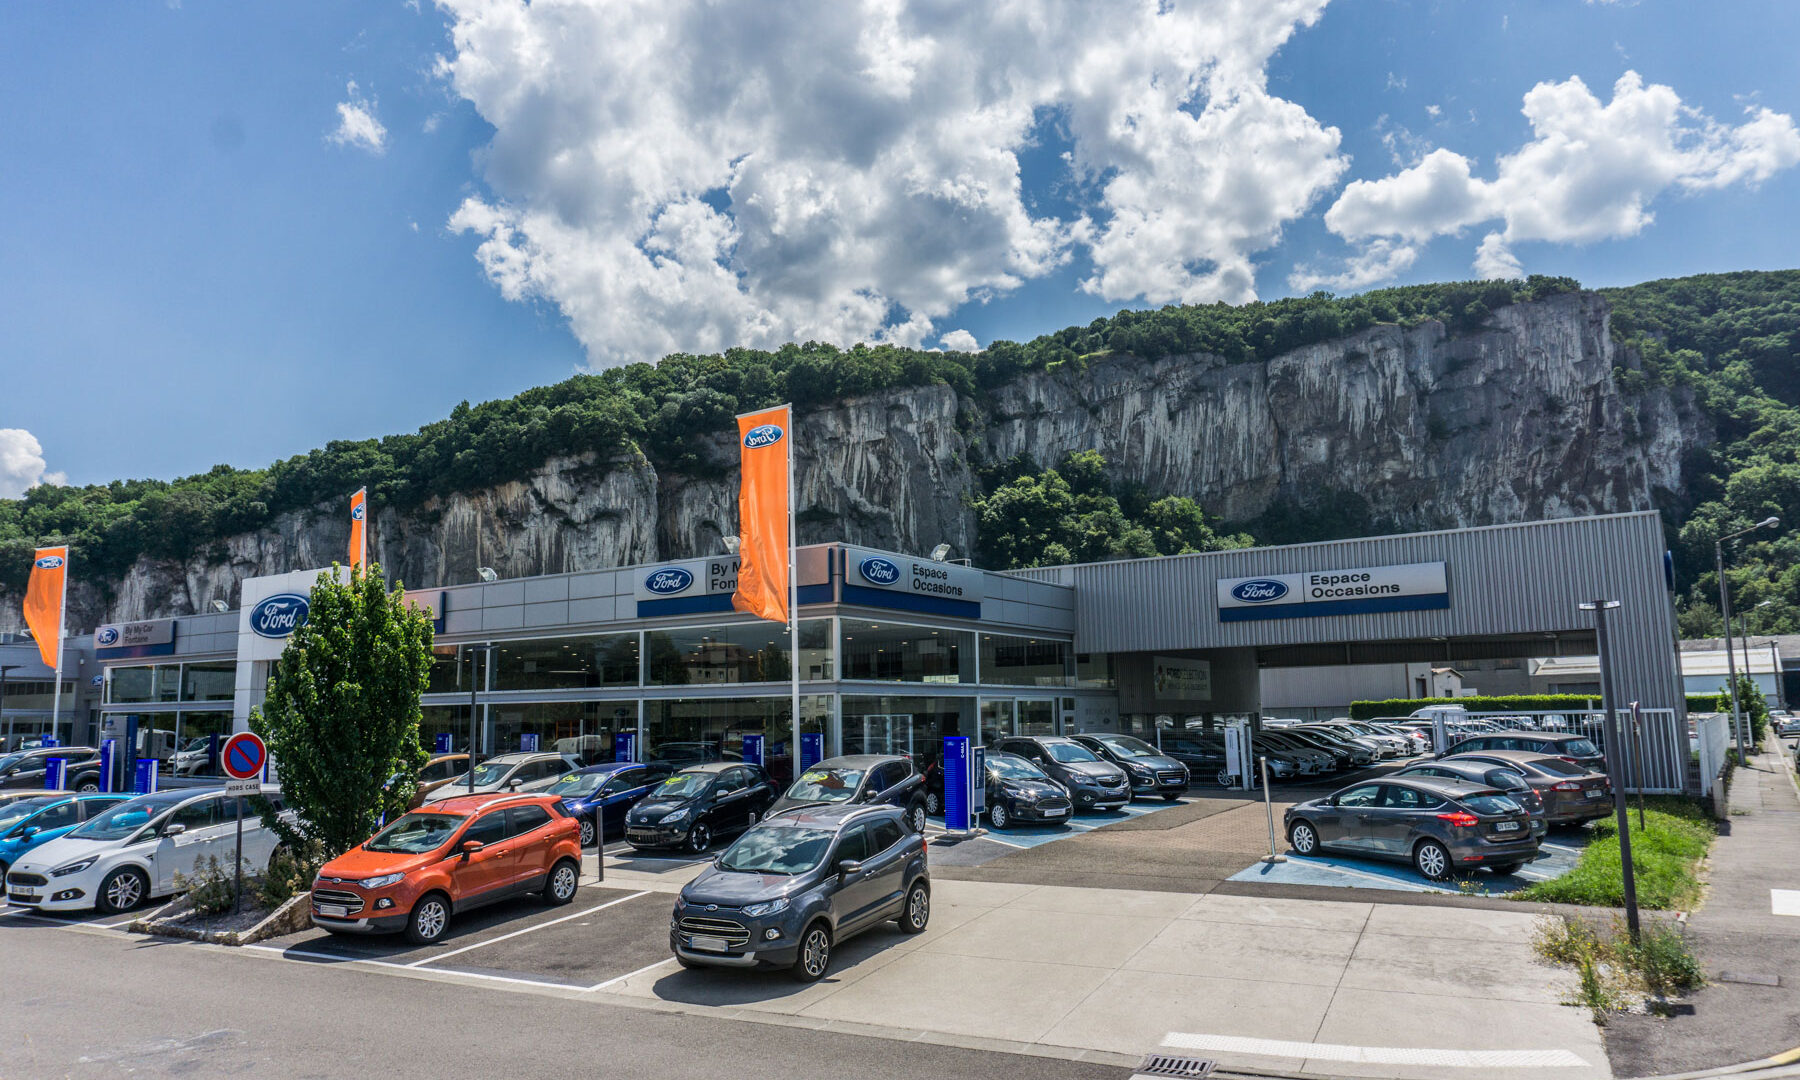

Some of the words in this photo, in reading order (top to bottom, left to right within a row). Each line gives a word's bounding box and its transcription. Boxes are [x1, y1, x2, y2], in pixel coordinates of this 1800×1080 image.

[711, 563, 728, 576] By
[869, 560, 894, 580] Ford
[912, 563, 948, 580] Espace
[652, 572, 681, 590] Ford
[912, 578, 963, 596] Occasions
[1310, 572, 1371, 588] Espace
[1241, 583, 1276, 599] Ford
[1311, 583, 1400, 599] Occasions
[260, 602, 298, 630] Ford
[125, 626, 133, 635] By
[134, 625, 143, 635] My
